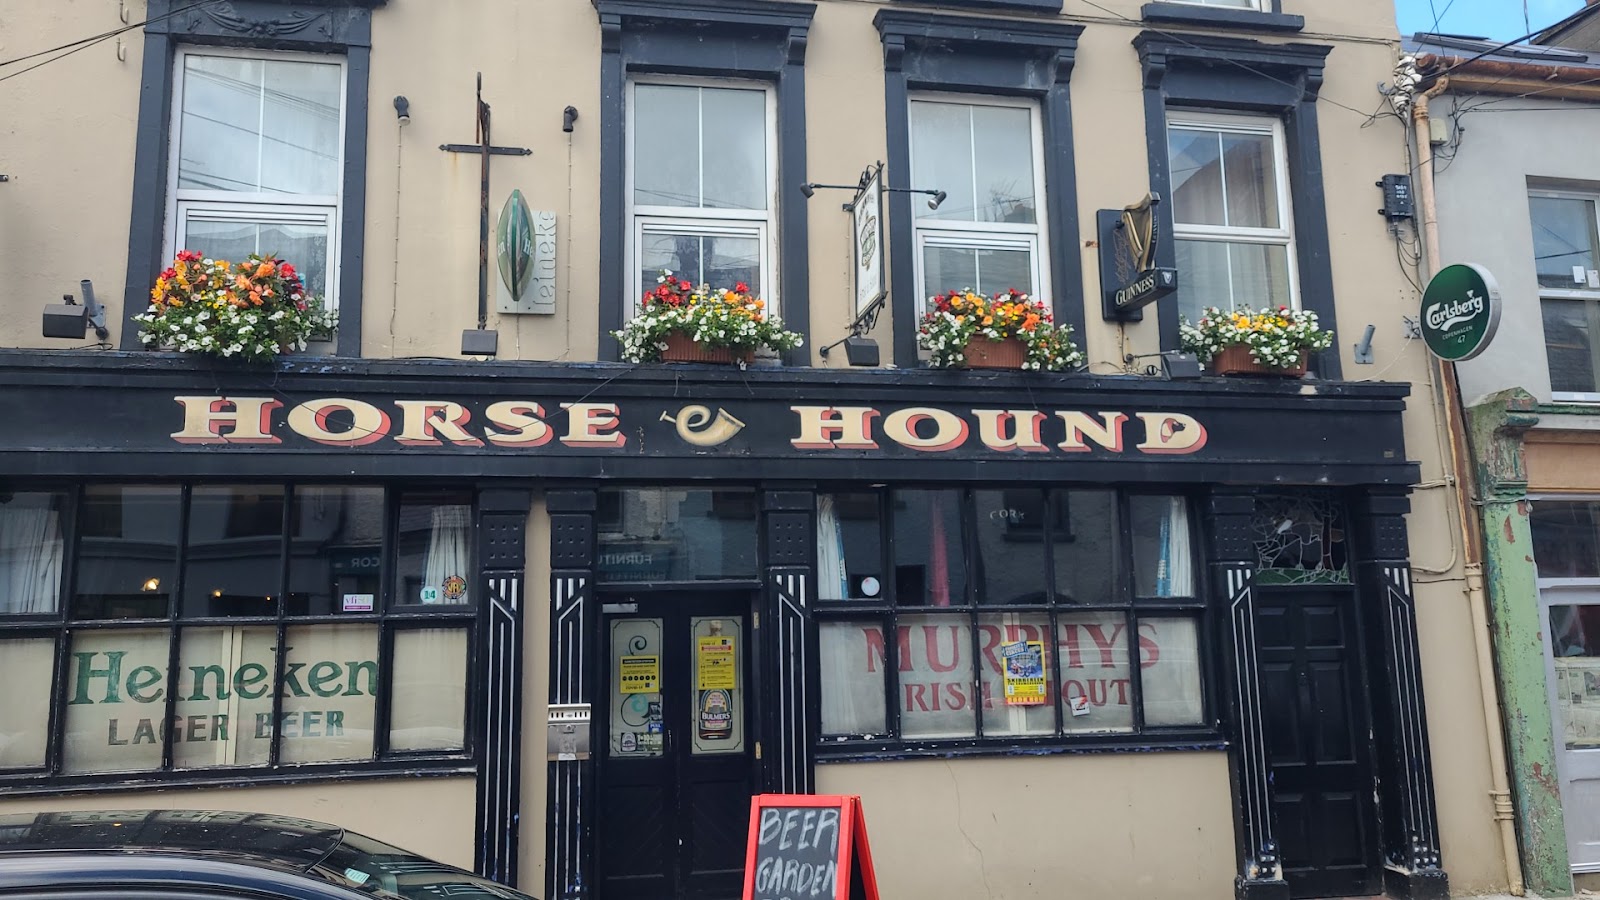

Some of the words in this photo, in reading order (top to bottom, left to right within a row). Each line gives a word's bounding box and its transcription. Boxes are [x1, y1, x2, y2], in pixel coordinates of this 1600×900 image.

[1115, 274, 1155, 305] GUINNESS
[1426, 295, 1484, 330] Carlsberg
[1442, 325, 1473, 340] COPENHAGEN
[170, 396, 627, 448] HORSE
[790, 406, 1208, 454] HOUND
[68, 646, 378, 706] Heneken
[903, 682, 993, 712] RISH
[108, 714, 230, 746] LAGER
[254, 710, 345, 739] BEER
[702, 711, 731, 720] BULMERS
[758, 808, 839, 857] BEER
[755, 856, 838, 899] GARDEN
